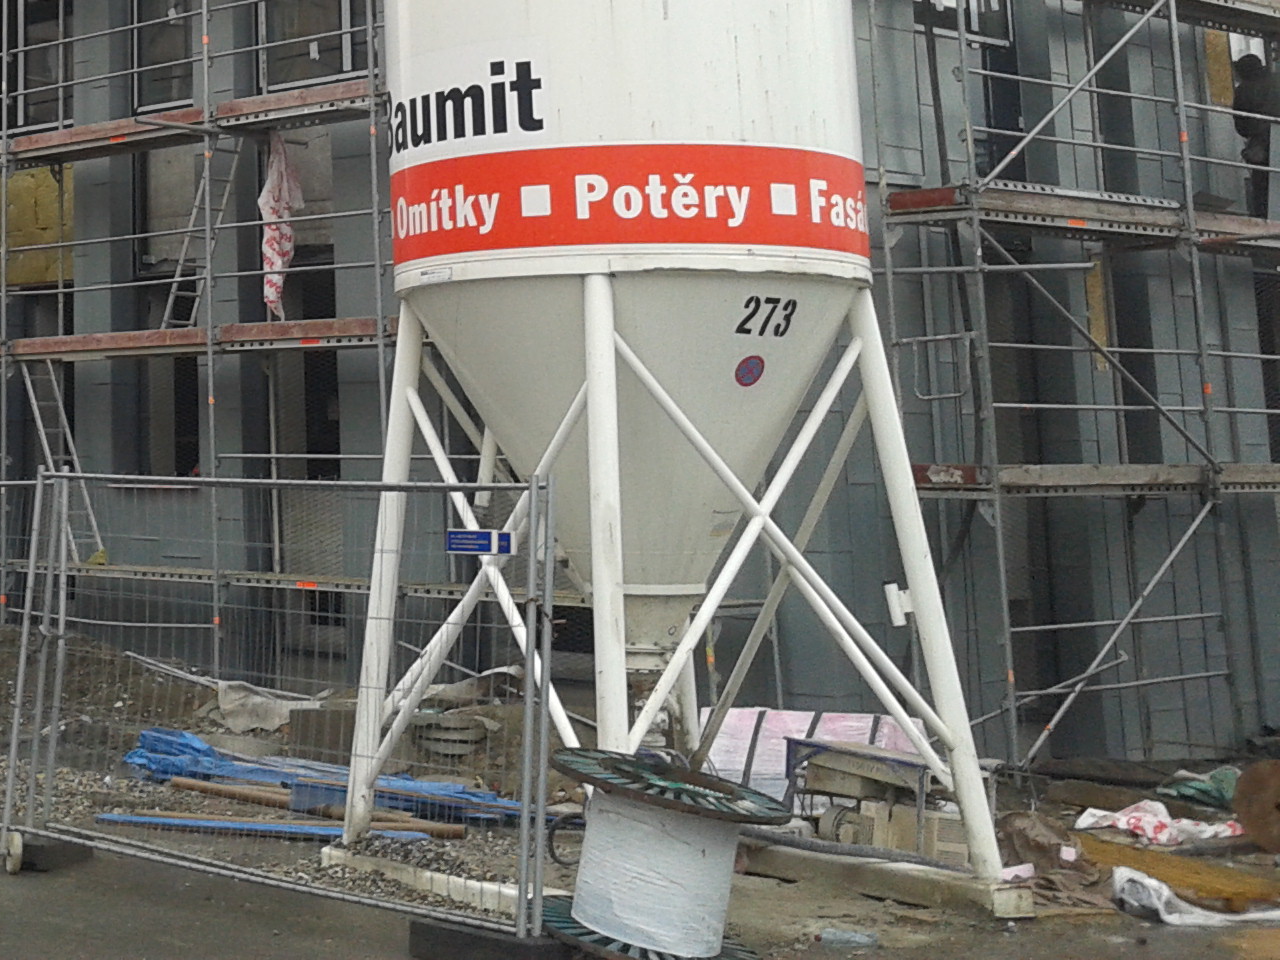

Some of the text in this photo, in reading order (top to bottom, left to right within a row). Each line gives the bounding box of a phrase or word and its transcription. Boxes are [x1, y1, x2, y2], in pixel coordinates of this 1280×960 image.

[396, 184, 500, 239] Omítky
[575, 173, 750, 227] Potěry
[735, 295, 798, 338] 273
